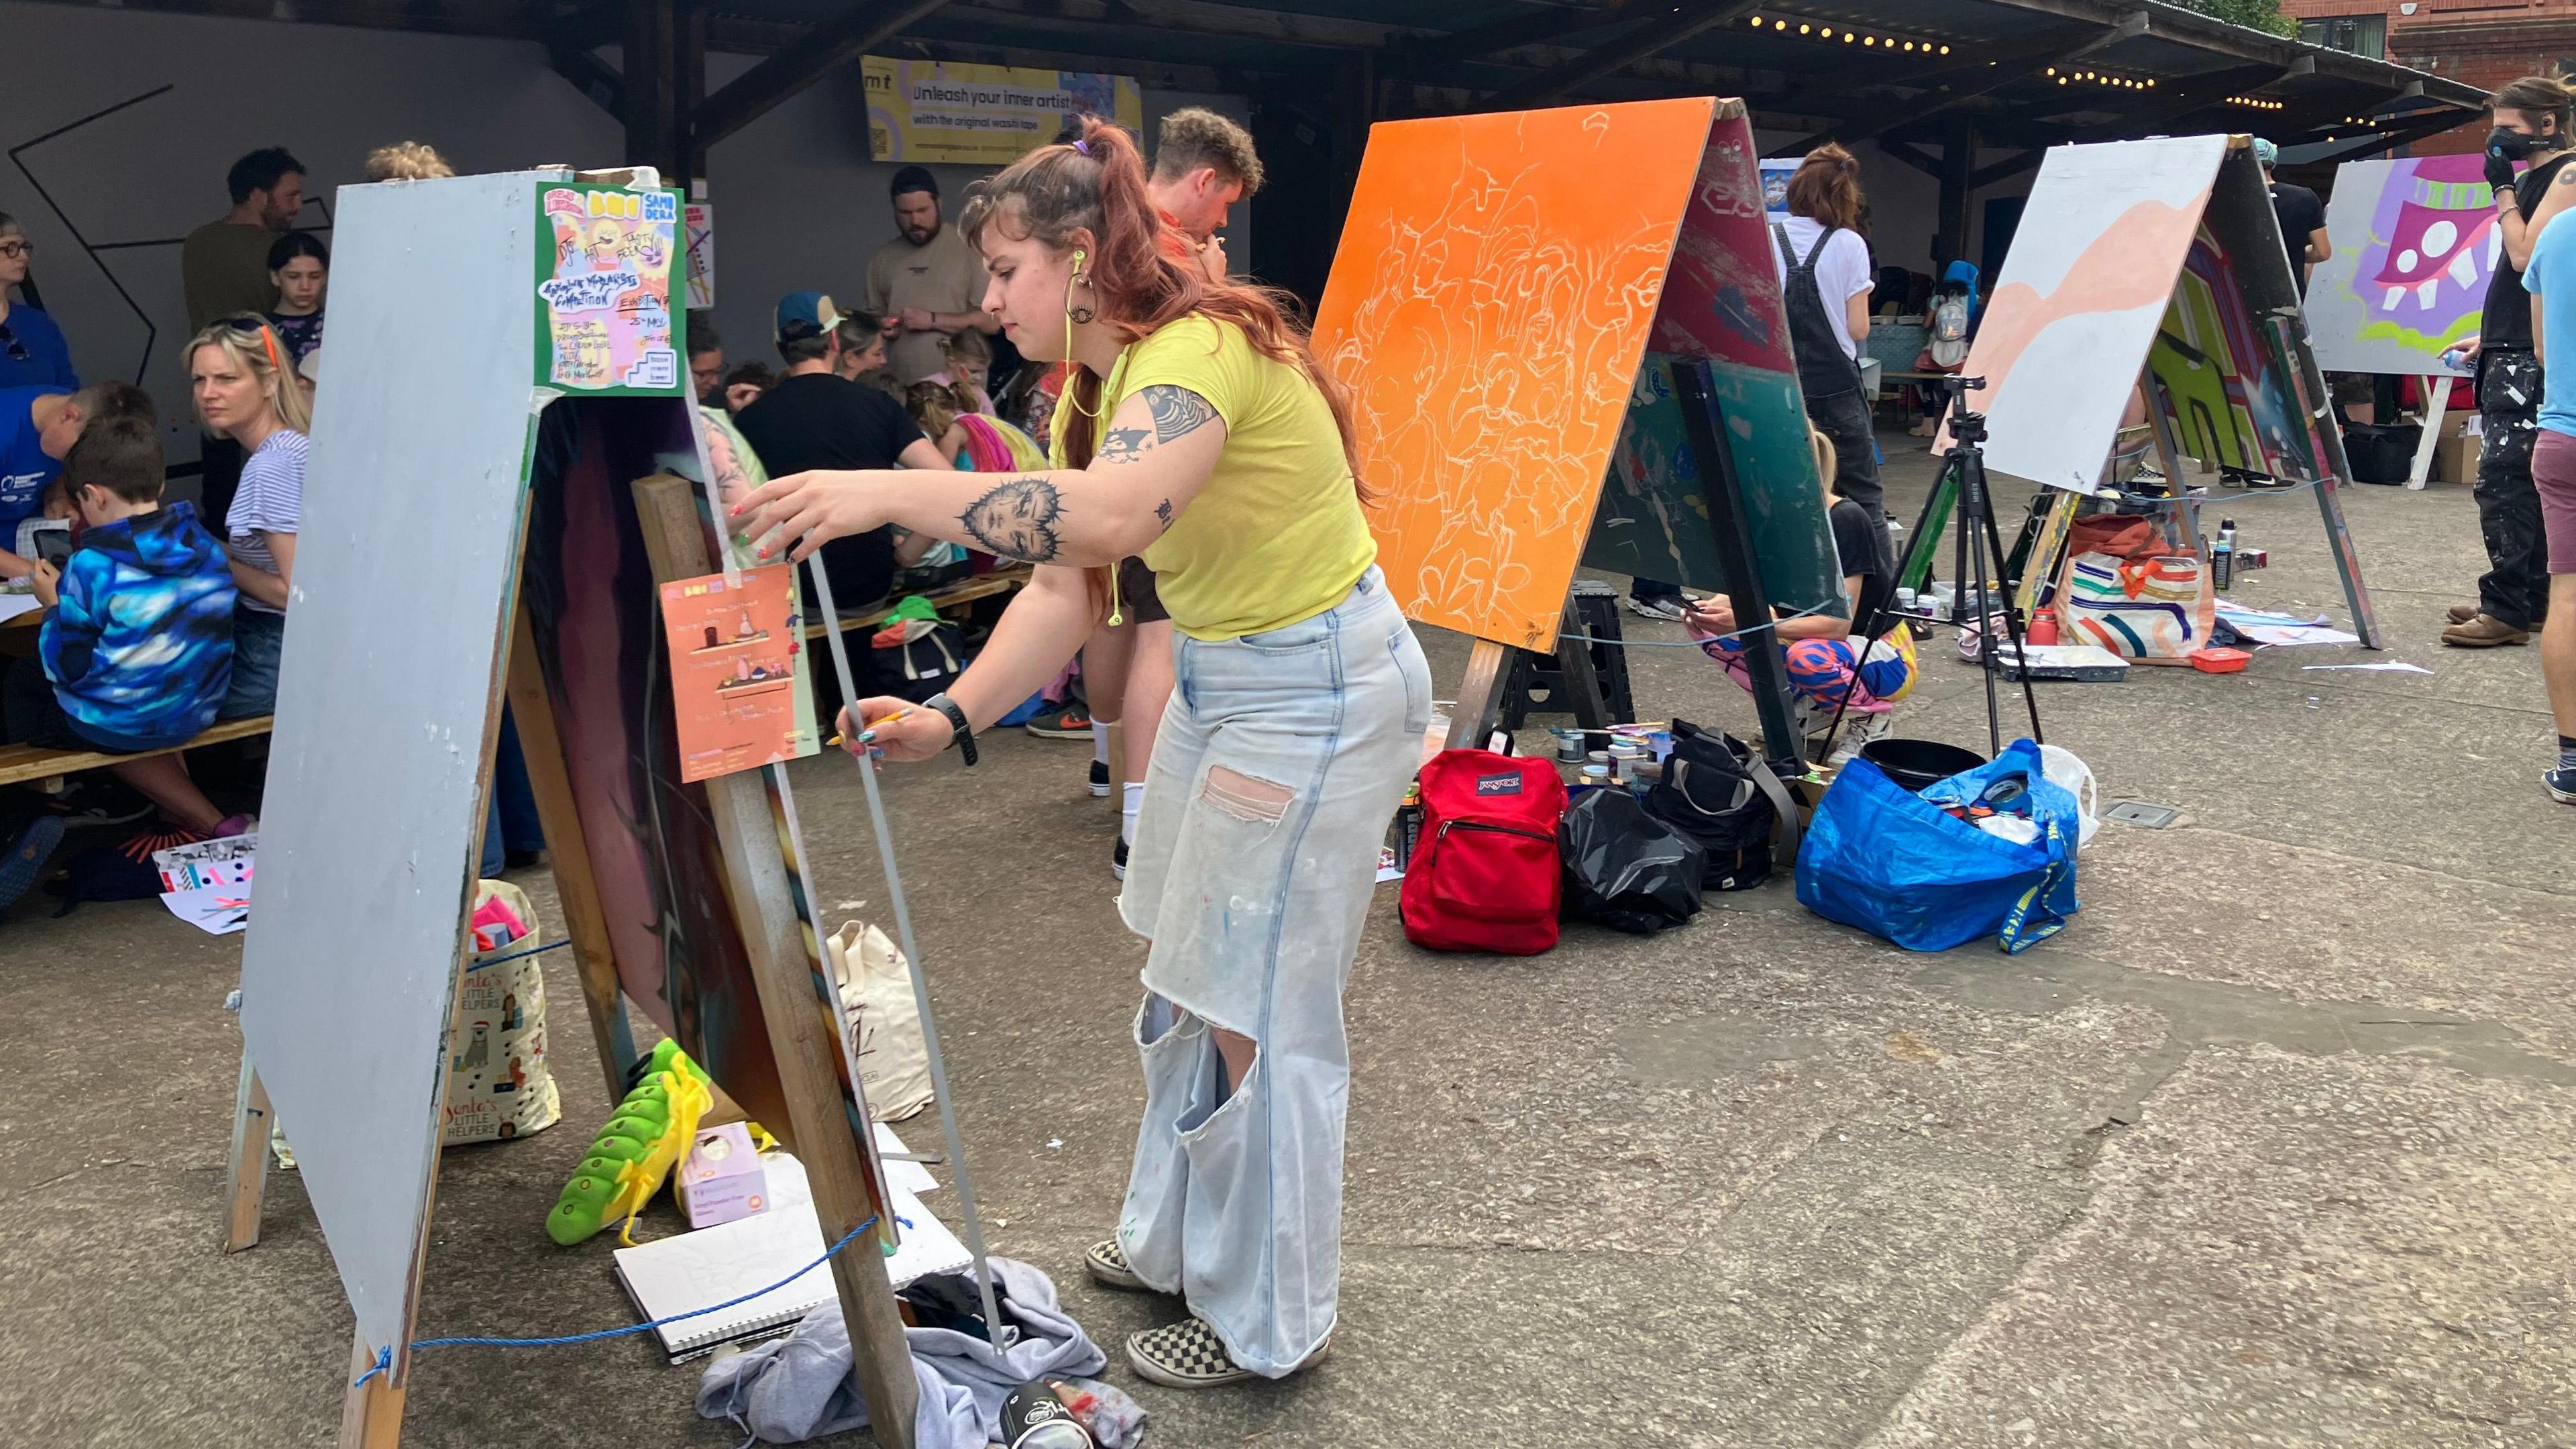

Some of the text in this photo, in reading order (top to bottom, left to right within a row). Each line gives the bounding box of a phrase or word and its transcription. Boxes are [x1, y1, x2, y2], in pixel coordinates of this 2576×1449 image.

[914, 86, 1071, 109] Unleash your inner artist
[913, 114, 938, 125] with
[939, 115, 953, 125] the
[955, 116, 989, 130] original
[1020, 119, 1038, 131] tape
[645, 209, 674, 221] DERA
[1479, 777, 1519, 790] JANSPORT
[462, 998, 500, 1010] ELPERS
[455, 1114, 489, 1126] LITTLE
[447, 1124, 495, 1137] HELPERS
